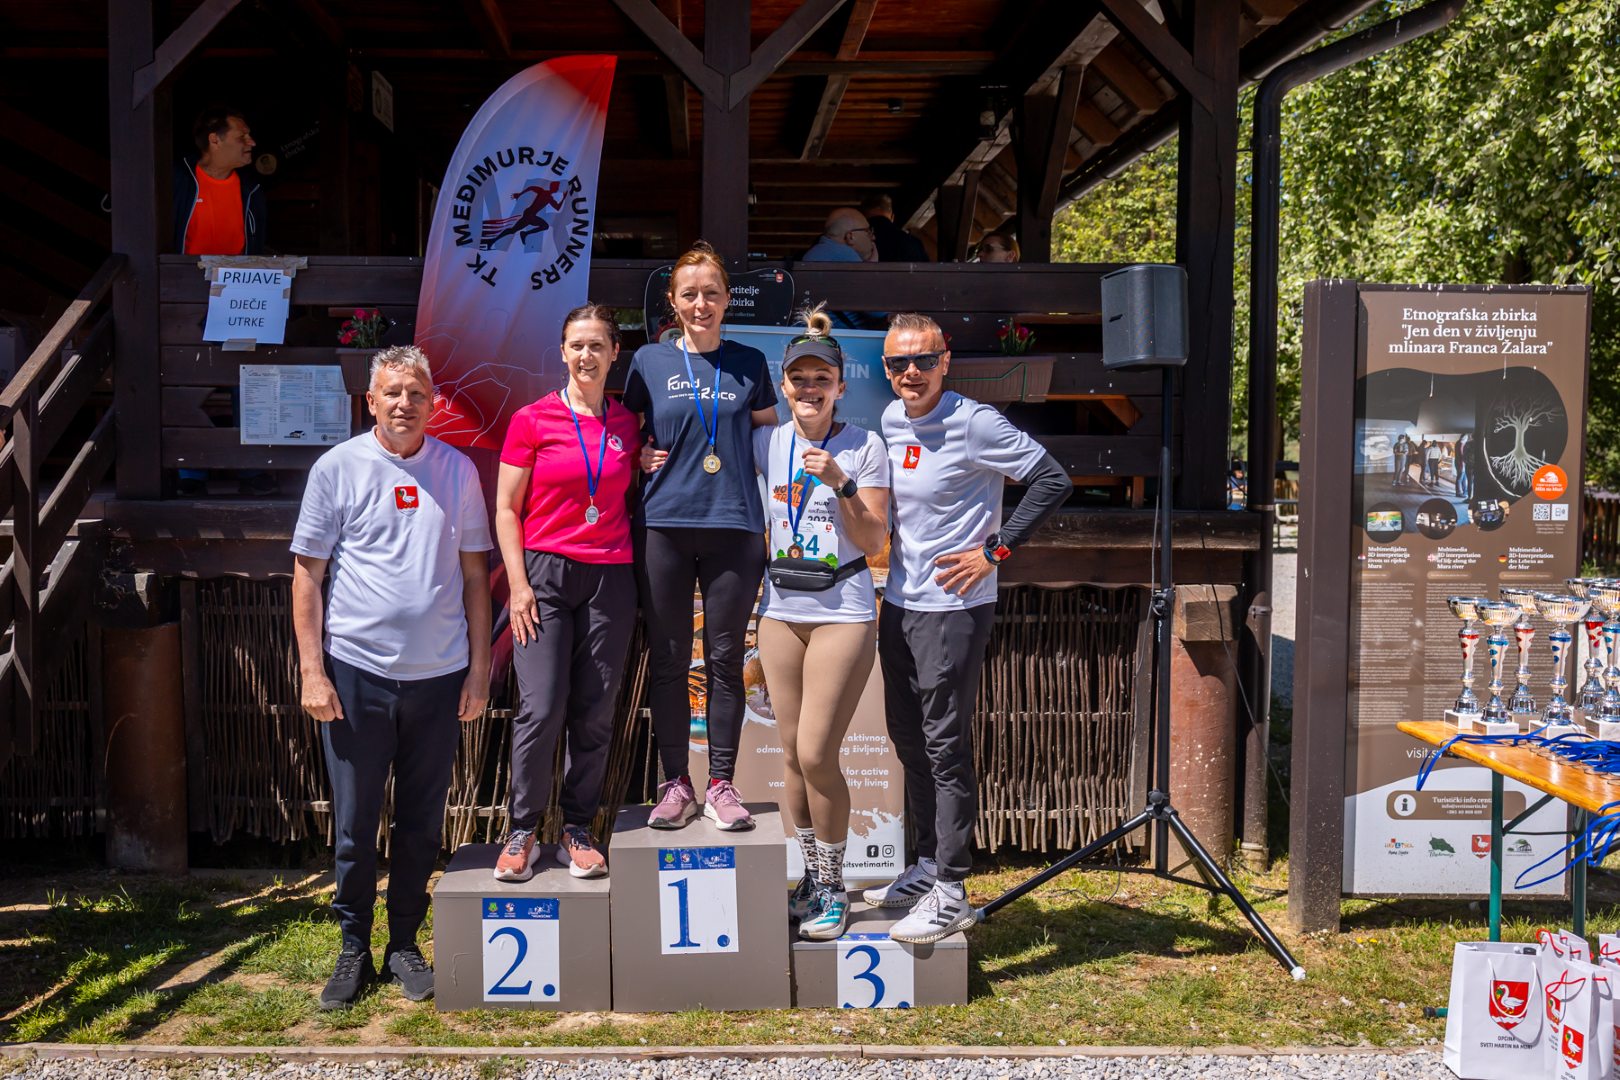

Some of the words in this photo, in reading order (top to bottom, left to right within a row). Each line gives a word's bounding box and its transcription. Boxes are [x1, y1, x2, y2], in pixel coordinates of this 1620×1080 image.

[452, 146, 570, 248] MEĐIMURJE
[530, 175, 589, 290] RUNNERS
[466, 252, 498, 287] TK
[223, 271, 282, 285] PRIJAVE
[729, 285, 760, 297] etitelje
[229, 298, 267, 310] DJEČJE
[228, 317, 265, 327] UTRKE
[1402, 307, 1489, 324] Etnografska
[1491, 308, 1538, 322] zbirka
[1401, 325, 1432, 340] "Jen
[1433, 325, 1460, 338] den
[1463, 328, 1473, 338] v
[1475, 324, 1537, 341] življenju
[1388, 341, 1446, 354] mlinara
[1449, 342, 1498, 354] Franca
[843, 363, 870, 379] TIN
[667, 373, 700, 391] Fund
[701, 386, 736, 401] Race
[847, 733, 887, 744] aktivnog
[852, 745, 890, 756] življenja
[845, 767, 859, 776] for
[860, 767, 889, 776] active
[864, 778, 889, 789] living
[843, 860, 895, 869] sitsvetimartin
[667, 877, 731, 948] 1.
[487, 926, 556, 996] 2.
[843, 944, 910, 1009] 3.
